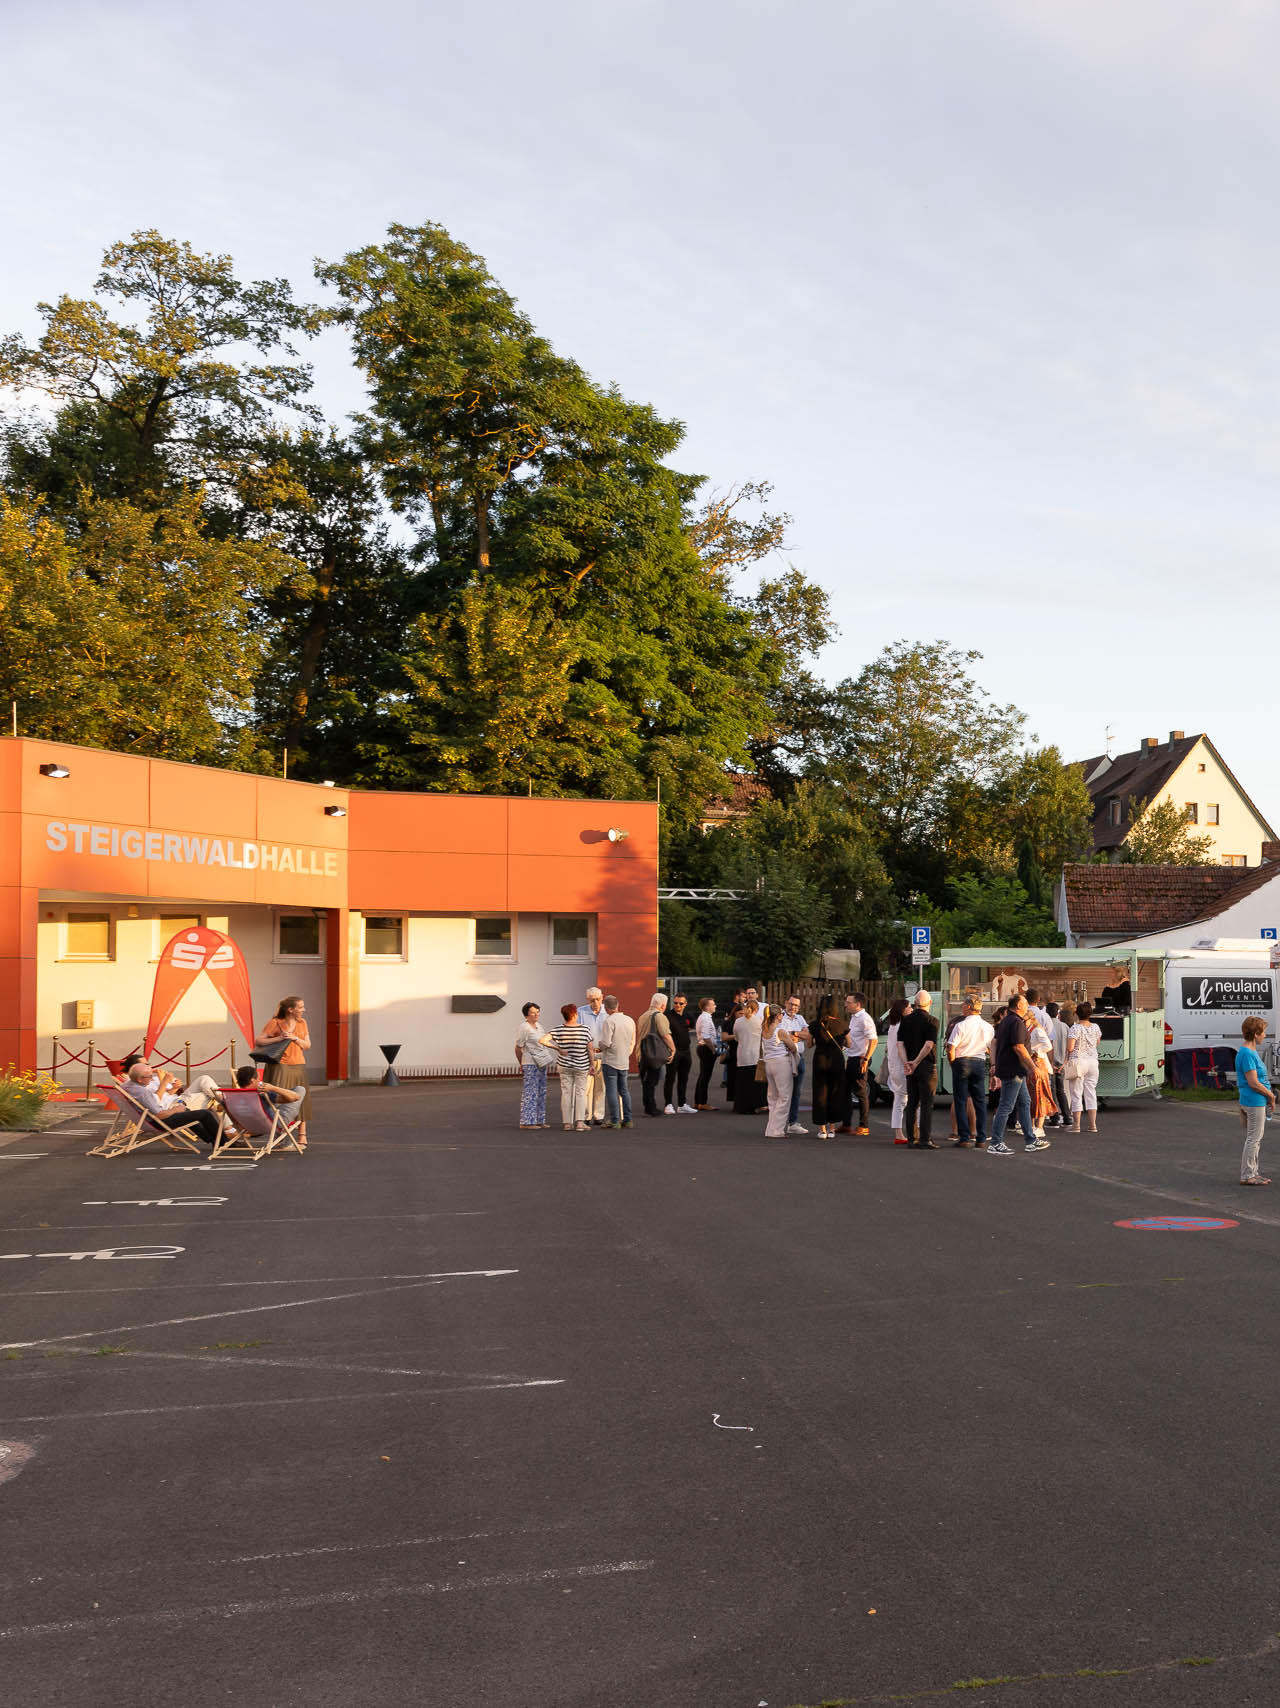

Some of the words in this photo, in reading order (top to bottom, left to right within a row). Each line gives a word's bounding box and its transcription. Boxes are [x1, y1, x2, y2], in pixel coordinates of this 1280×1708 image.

[46, 822, 338, 877] STEIGERWALDHALLE
[916, 928, 927, 943] P
[1263, 930, 1274, 940] P
[1215, 979, 1269, 993] neuland
